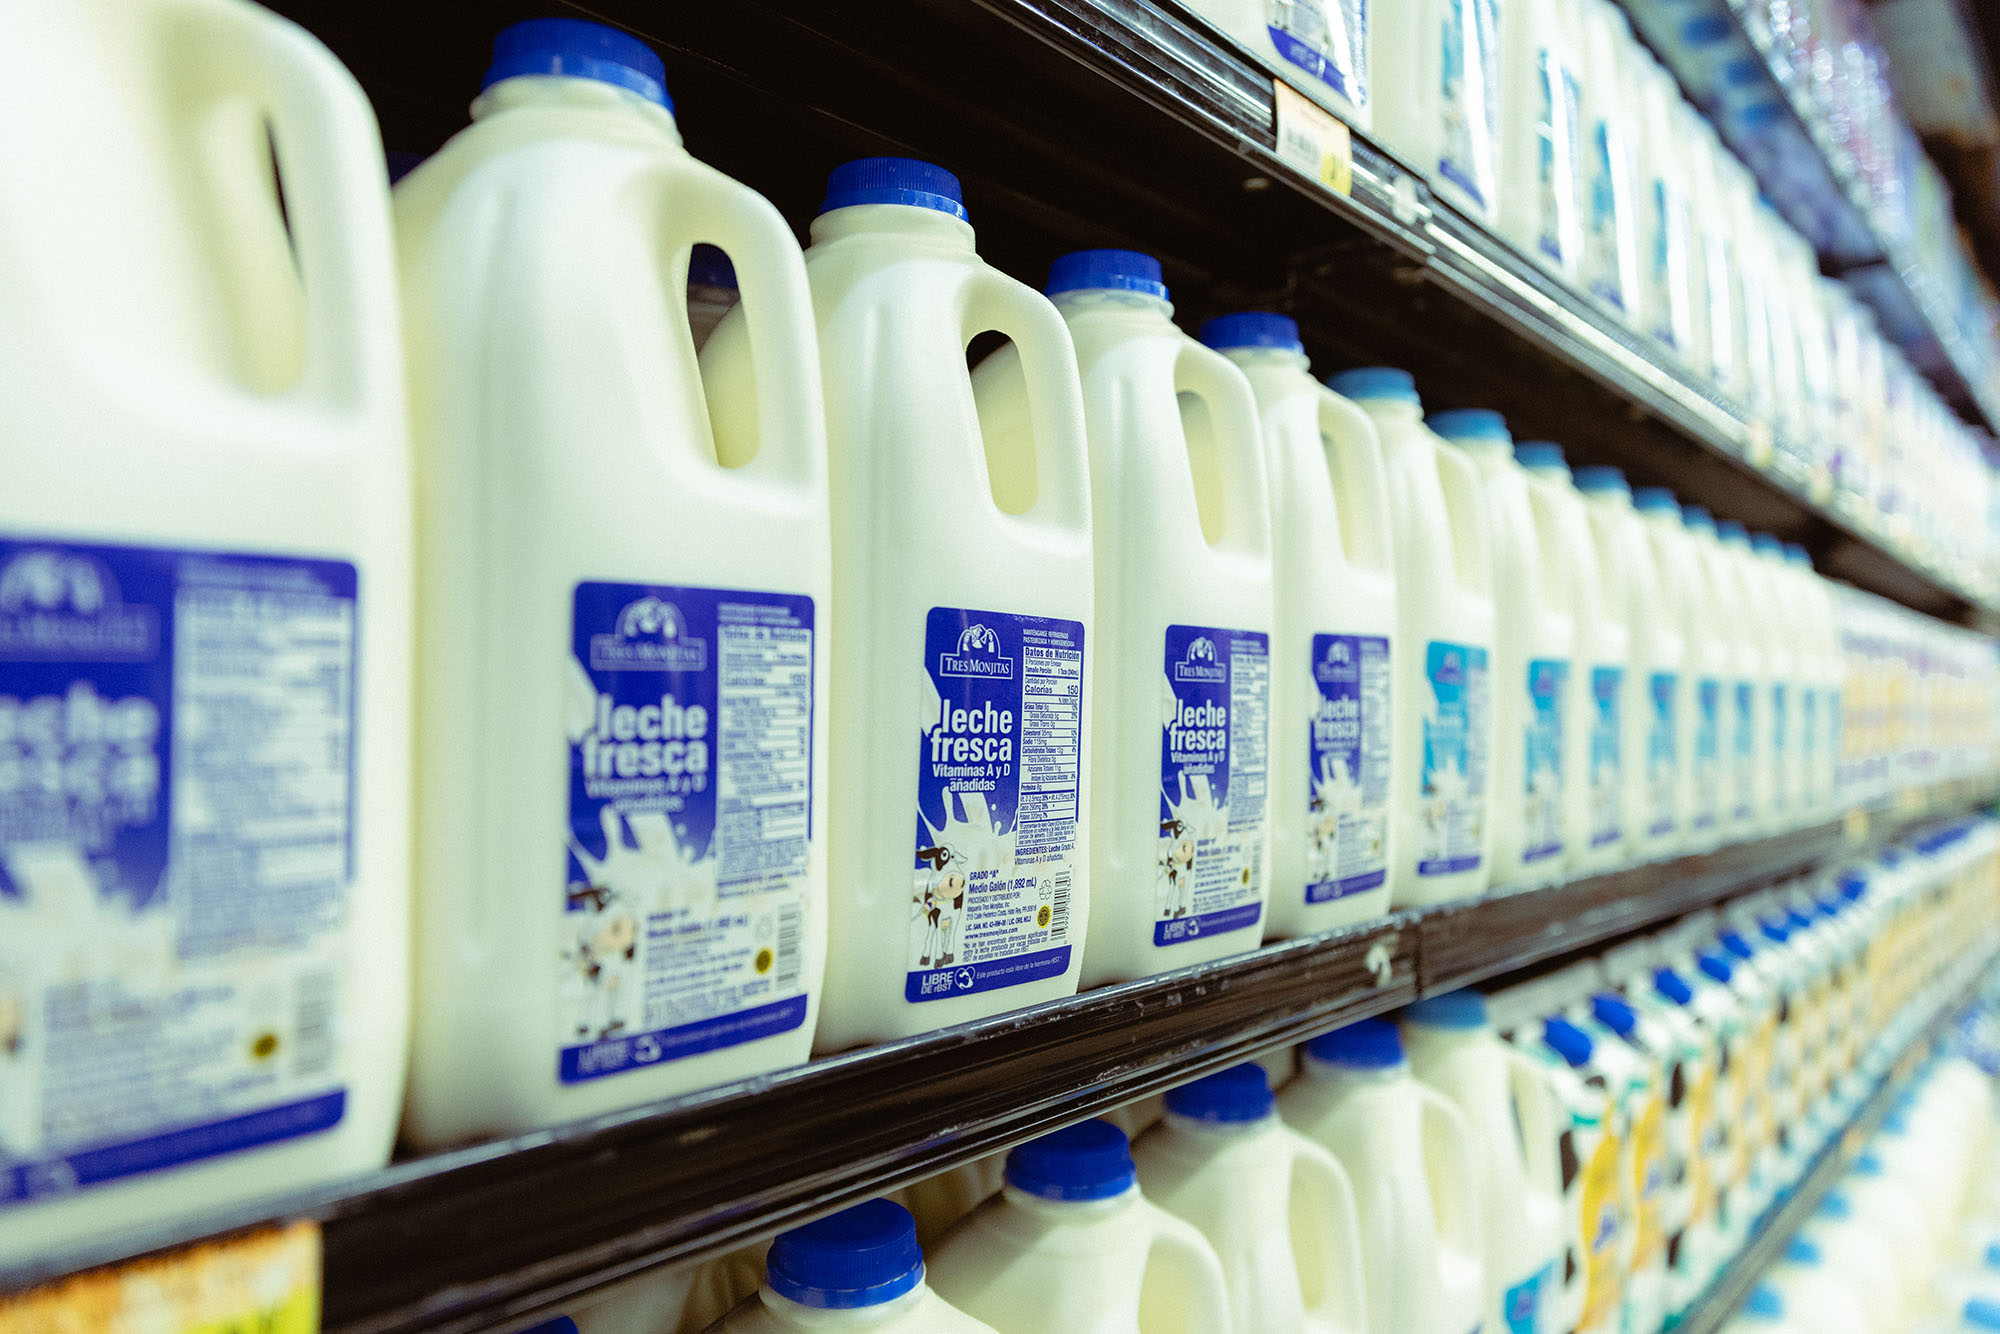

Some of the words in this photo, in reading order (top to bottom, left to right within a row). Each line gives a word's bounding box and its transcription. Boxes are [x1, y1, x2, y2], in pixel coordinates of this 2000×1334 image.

[1026, 647, 1044, 656] Datos
[1045, 648, 1053, 658] de
[1055, 650, 1079, 660] Nutrición
[945, 657, 968, 672] TRES
[969, 659, 1010, 675] MONJITAS
[1025, 684, 1052, 693] Calorías
[1067, 685, 1078, 694] 150
[597, 694, 708, 741] leche
[943, 699, 1013, 734] leche
[1177, 699, 1226, 727] leche
[1169, 722, 1226, 751] fresca
[931, 728, 1012, 762] fresca
[582, 731, 708, 777] fresca
[932, 764, 985, 777] Vitaminas
[986, 764, 994, 776] A
[996, 766, 1002, 778] y
[1004, 764, 1010, 776] D
[950, 778, 996, 792] añadidas
[1015, 846, 1048, 856] INGREDIENTES:
[970, 870, 988, 880] GRADO
[968, 882, 988, 894] Medio
[989, 880, 1006, 892] Galón
[1008, 878, 1025, 891] (1,892
[1026, 876, 1036, 888] mL)
[964, 928, 1018, 940] www.tresmonjitas.com
[922, 972, 954, 986] LIBRE
[986, 969, 1005, 978] producto
[921, 985, 932, 995] DE
[934, 982, 952, 993] rBST
